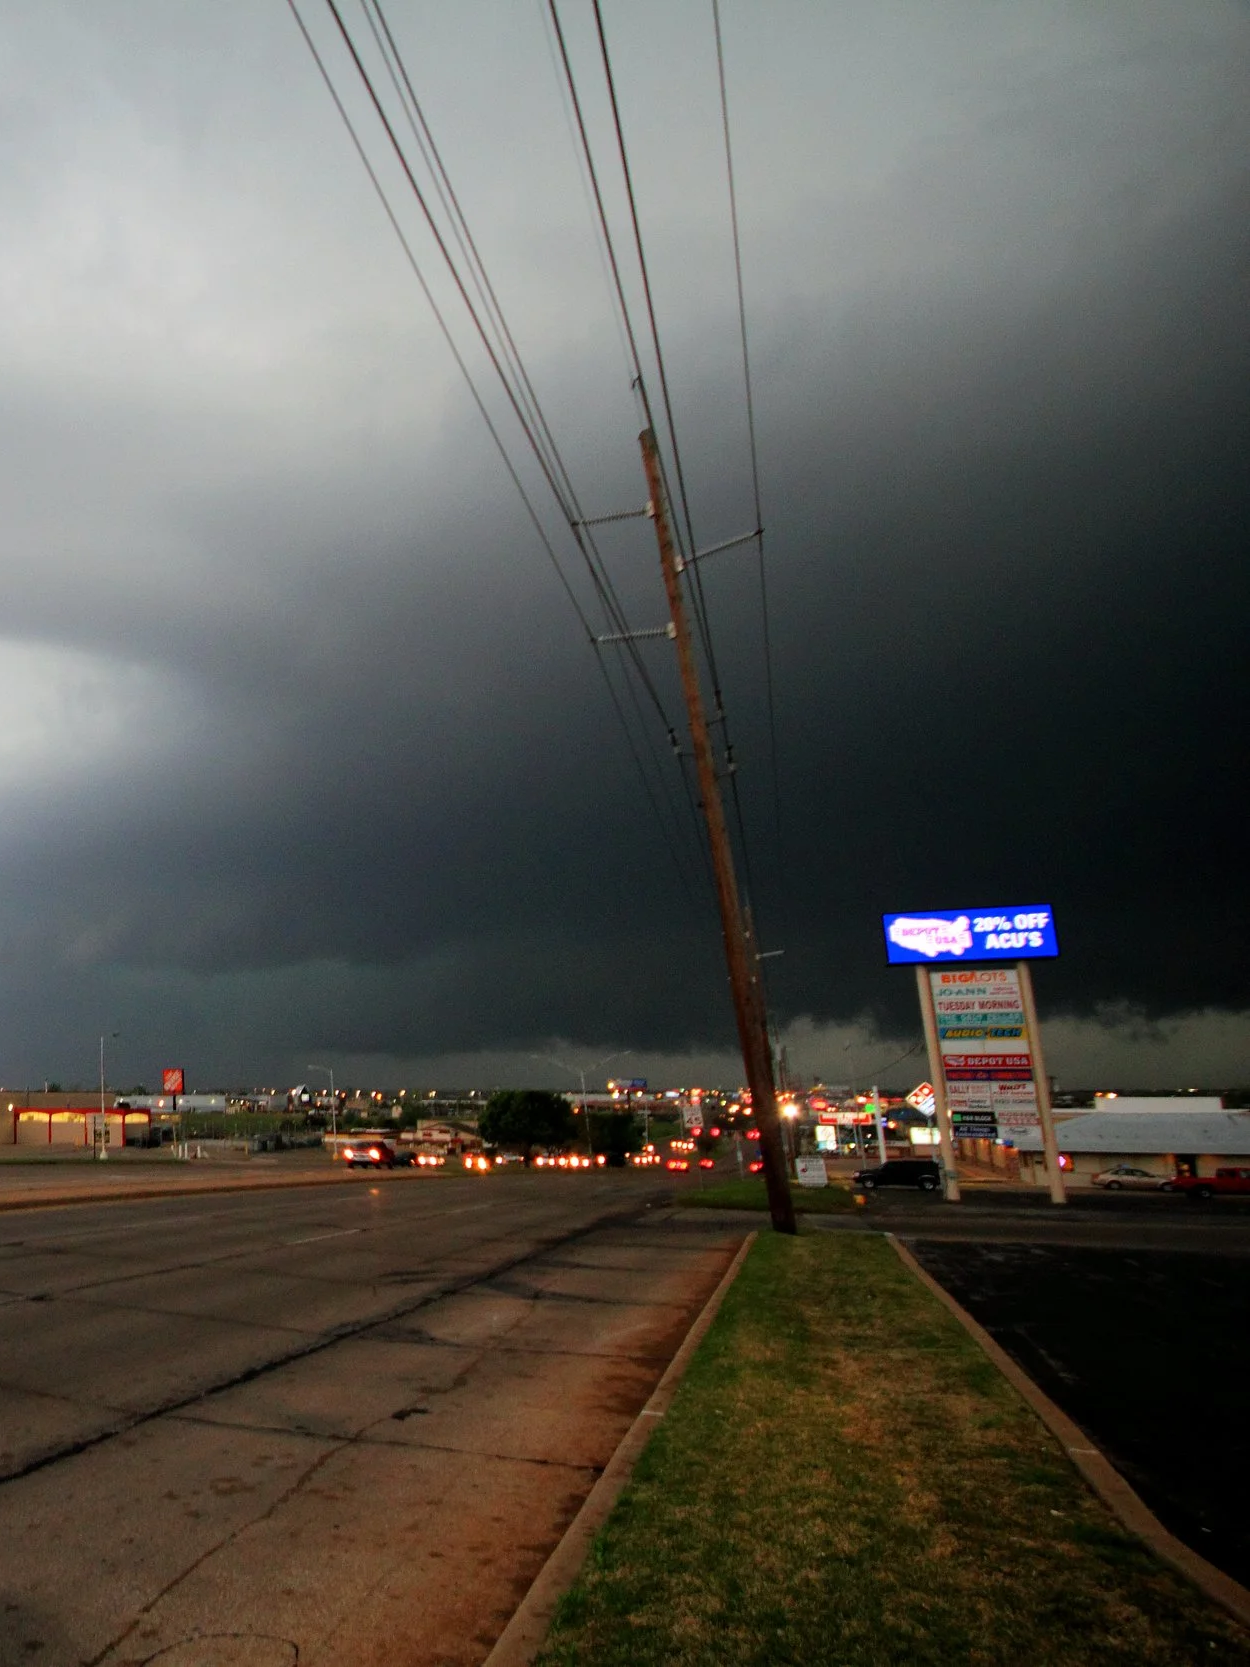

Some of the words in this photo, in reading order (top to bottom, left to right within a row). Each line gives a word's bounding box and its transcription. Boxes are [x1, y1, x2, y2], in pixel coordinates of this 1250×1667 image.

[1013, 912, 1049, 931] OFF
[985, 931, 1044, 949] ACU'S
[937, 1000, 976, 1012] TUESDAY
[978, 1000, 1020, 1011] MORNING
[967, 1056, 1003, 1065] DEPOT
[1006, 1056, 1028, 1065] USA
